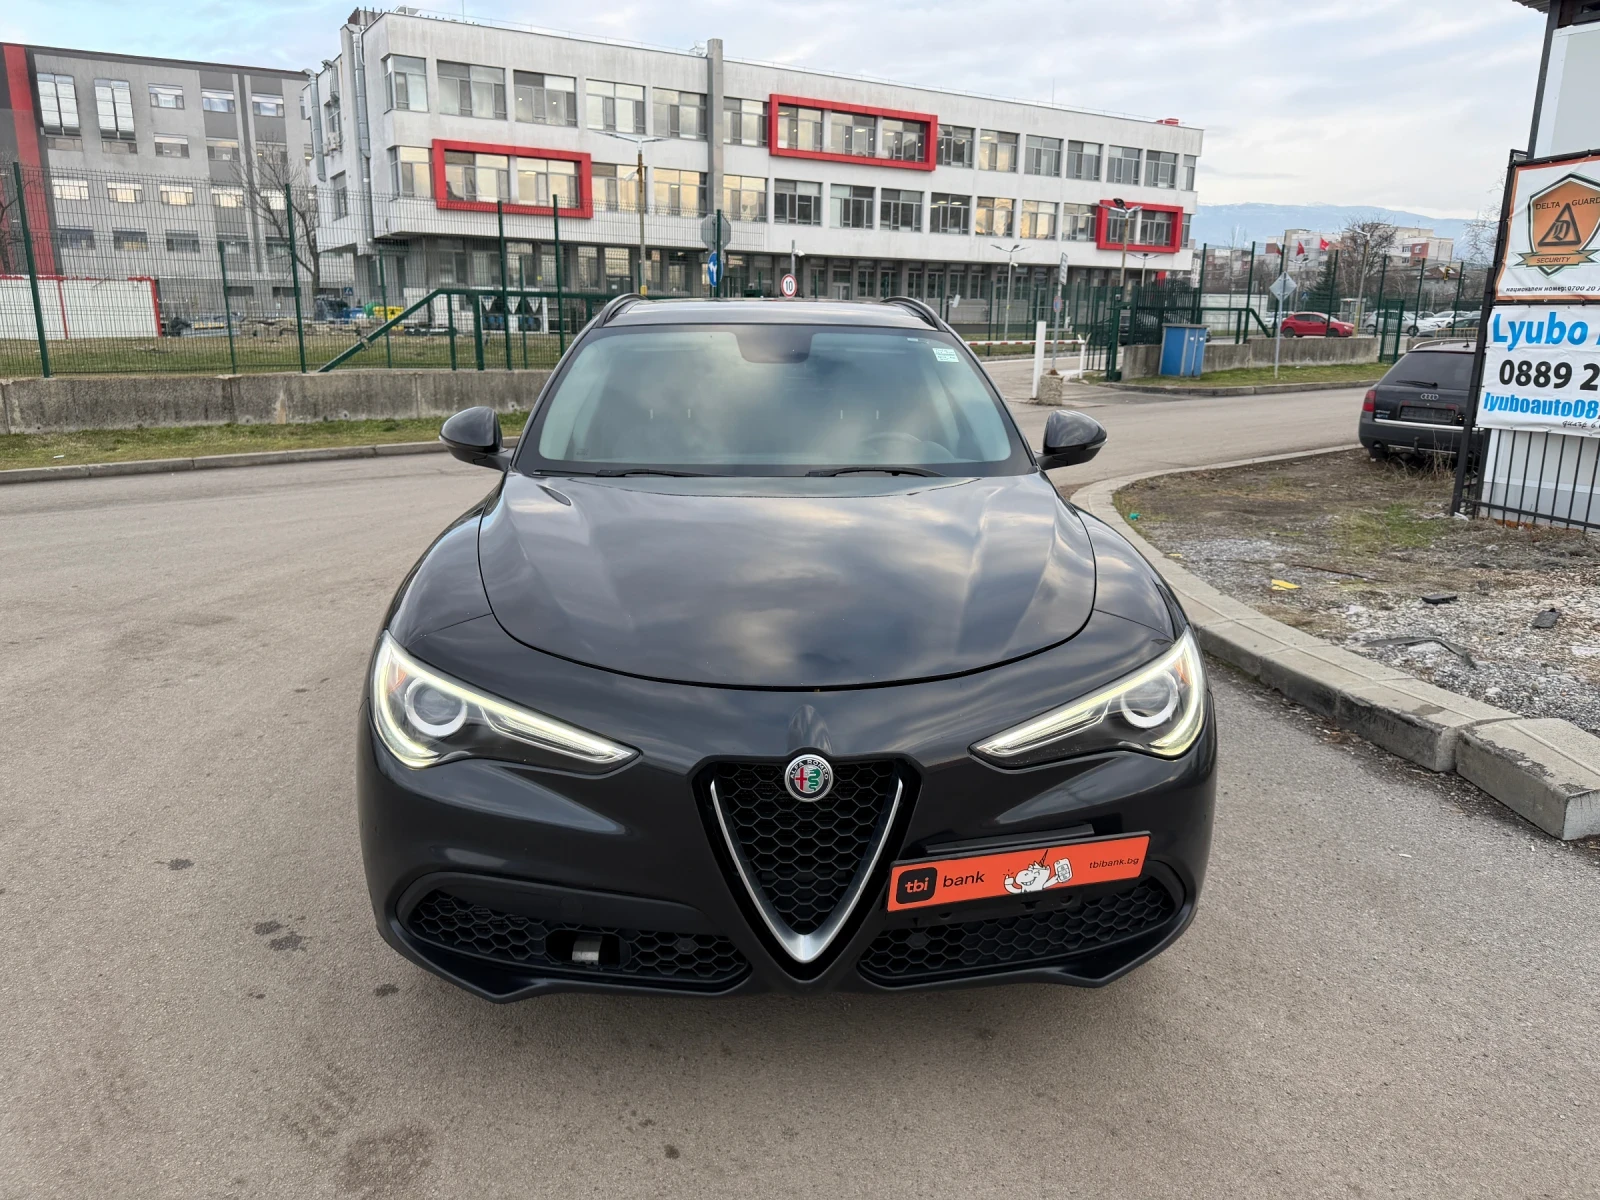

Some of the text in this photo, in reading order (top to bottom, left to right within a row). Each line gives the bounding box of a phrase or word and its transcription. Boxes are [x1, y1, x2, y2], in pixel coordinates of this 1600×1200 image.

[1535, 201, 1561, 210] DELTA
[1536, 256, 1572, 264] SECURITY
[785, 280, 793, 292] 10
[1492, 311, 1589, 352] Lyubo
[1499, 359, 1573, 389] 0889
[904, 857, 1140, 893] tbi bank tbibank.bg
